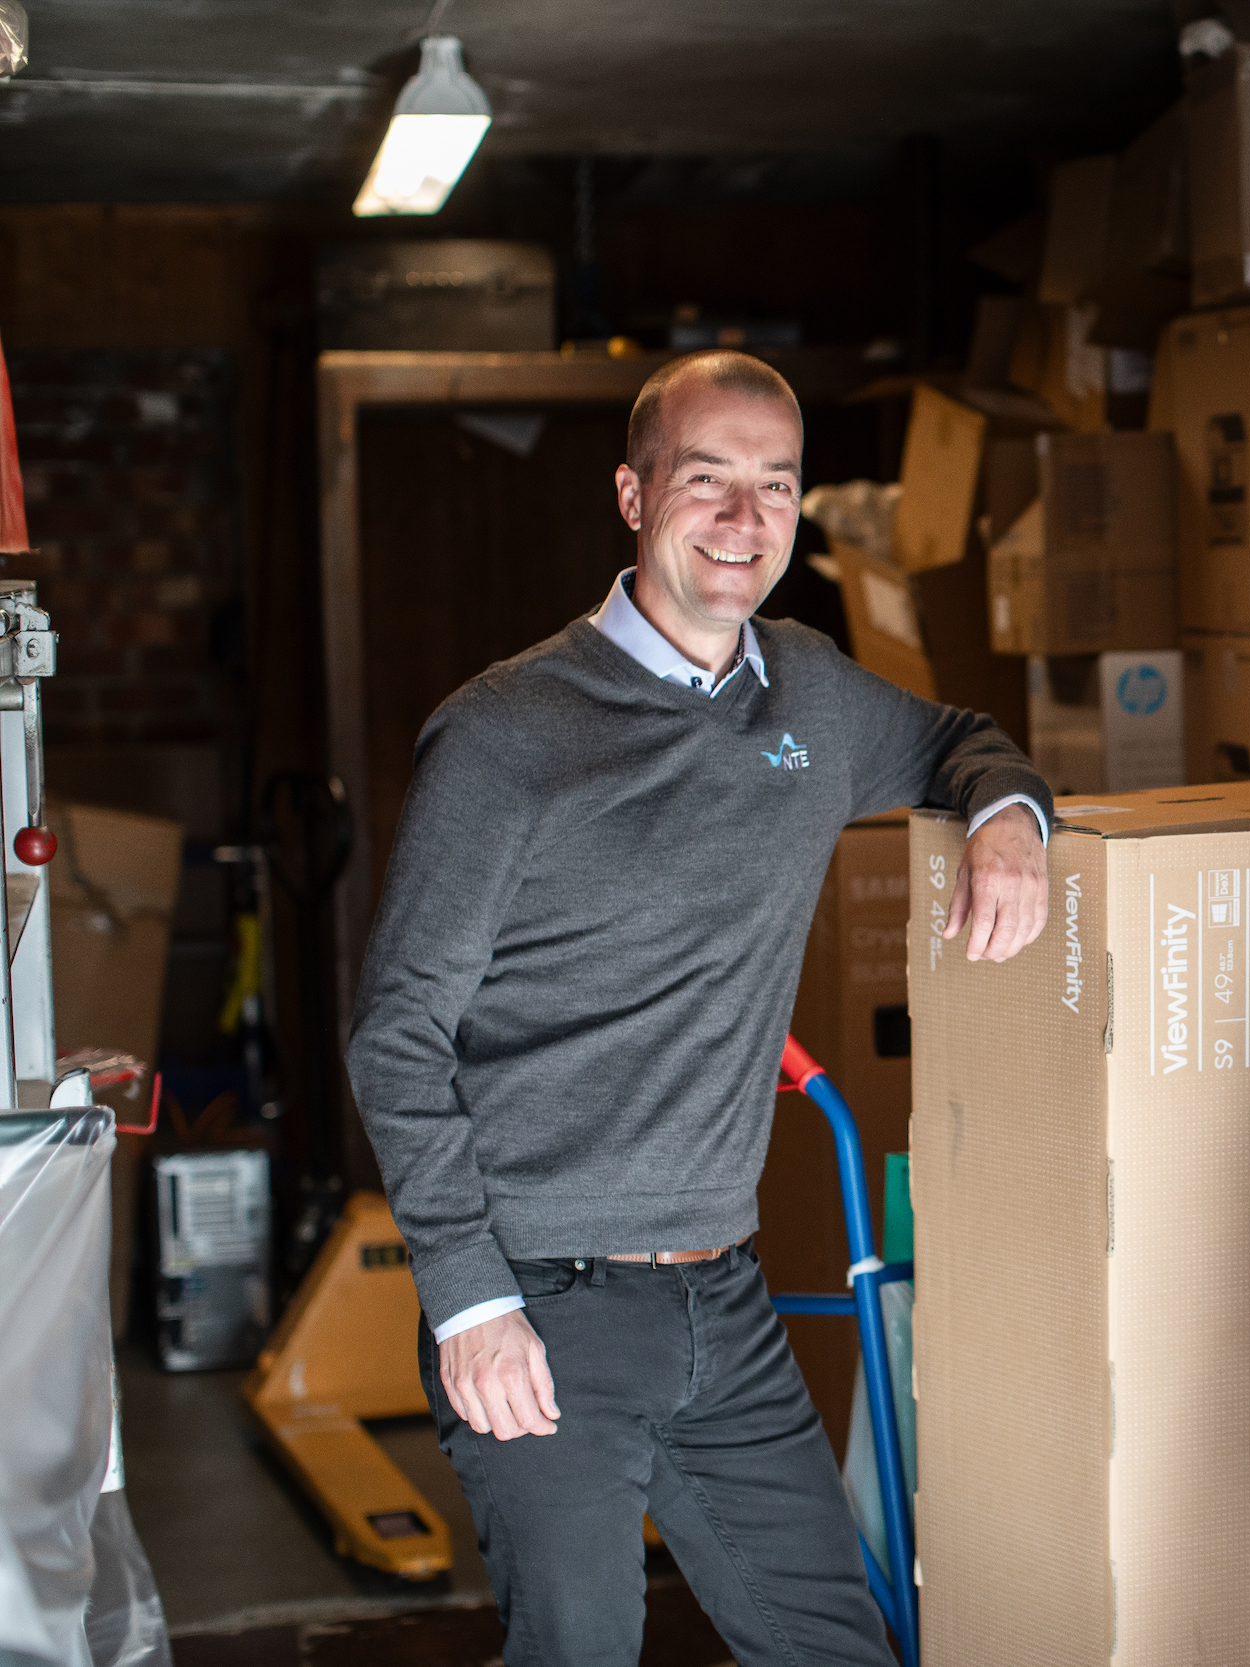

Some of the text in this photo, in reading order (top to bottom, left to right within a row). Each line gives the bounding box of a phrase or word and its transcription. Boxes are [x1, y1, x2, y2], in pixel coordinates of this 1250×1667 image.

[783, 750, 810, 770] NTE
[929, 854, 946, 890] S9
[1220, 873, 1229, 895] DeX
[930, 900, 947, 936] 49
[1061, 873, 1082, 1014] ViewFinity
[1160, 903, 1196, 1075] ViewFinity
[1214, 973, 1234, 1069] S9 49
